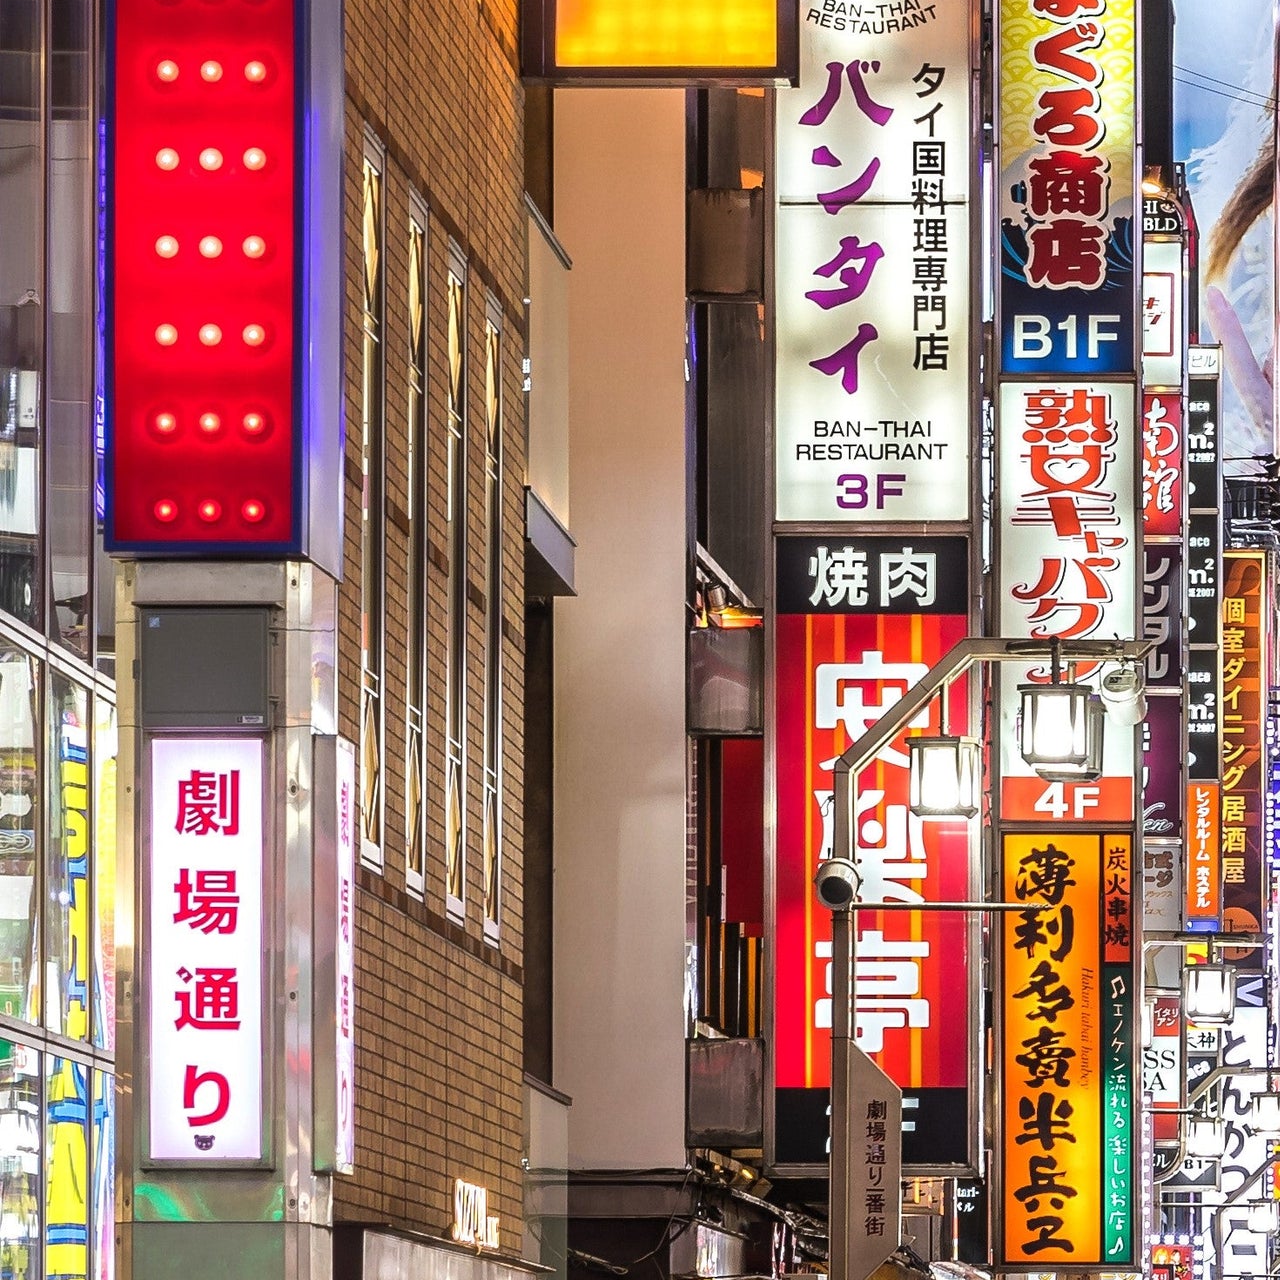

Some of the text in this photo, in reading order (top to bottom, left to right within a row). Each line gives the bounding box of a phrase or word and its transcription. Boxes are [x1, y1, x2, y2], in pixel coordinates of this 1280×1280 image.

[806, 4, 939, 36] RESTAURANT
[798, 59, 895, 395] バンタイ
[910, 61, 950, 372] タイ国料理専門店
[1013, 313, 1121, 359] B1F
[795, 441, 949, 463] RESTAURANT
[813, 419, 933, 440] BAN-THAI
[836, 472, 907, 510] 3F
[808, 546, 937, 608] 焼肉
[1144, 556, 1173, 680] レンタル
[1223, 597, 1246, 884] 個室ダイニング居酒屋
[1034, 785, 1101, 818] 4F
[1195, 788, 1211, 861] レンタルルーム
[1105, 847, 1130, 947] 炭火串焼
[173, 769, 241, 1128] 劇場通り
[865, 1099, 887, 1237] 劇場通り一番街
